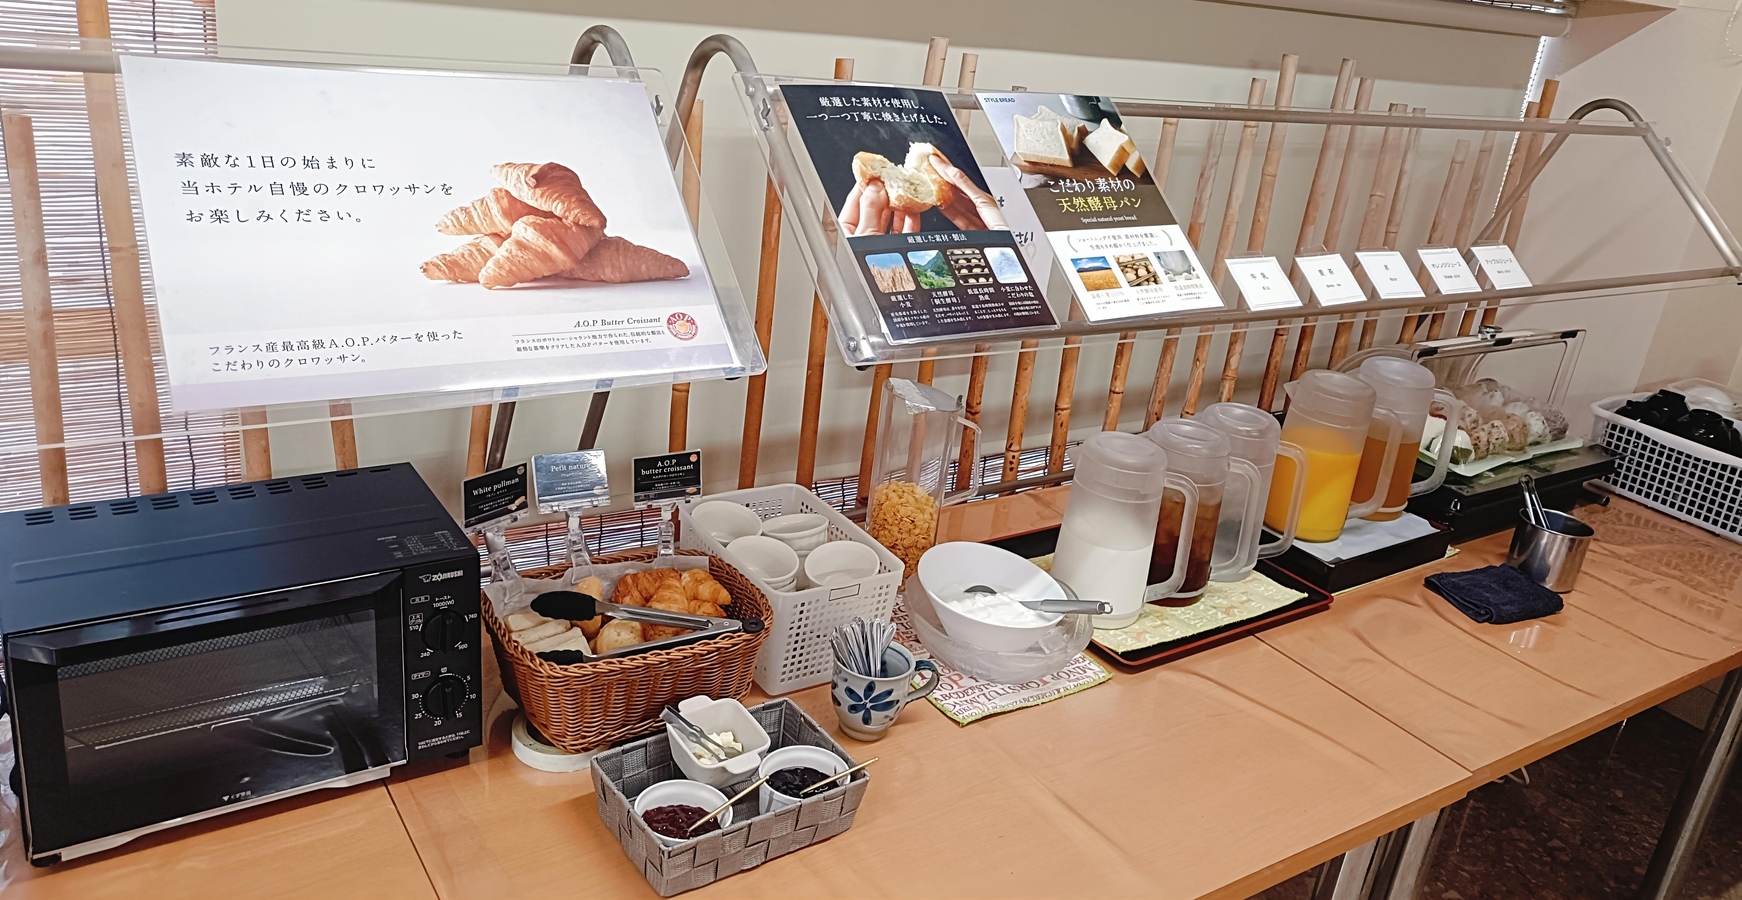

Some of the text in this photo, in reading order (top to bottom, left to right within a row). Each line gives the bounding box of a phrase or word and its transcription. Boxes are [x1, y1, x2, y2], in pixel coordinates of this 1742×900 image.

[819, 97, 925, 109] 厳選した素材を使用し、
[806, 112, 947, 125] 一つ一つ丁寧に焼き上げました。
[174, 152, 376, 170] 素敵な1日の始まりに
[180, 181, 452, 197] 当ホテル自慢のクロワッサンを
[1047, 177, 1135, 193] こだわり素材の
[1056, 196, 1141, 213] 天然酵母パン
[186, 208, 363, 224] お楽しみください。
[906, 234, 967, 244] 厳選した素材・製法
[890, 293, 914, 302] 厳選した
[930, 290, 955, 298] 天然酵母
[573, 316, 661, 329] A.O.P Butter Croissant
[670, 313, 691, 324] AOP
[209, 330, 464, 356] フランス産最高級A.O.P.バターを使った
[211, 353, 366, 372] こだわりのクロワッサン。
[641, 468, 663, 476] butter
[663, 464, 694, 473] croissant
[656, 459, 677, 468] A.O.P
[472, 486, 492, 496] White
[493, 477, 520, 492] pullman
[414, 712, 423, 720] 25
[433, 719, 442, 727] 20
